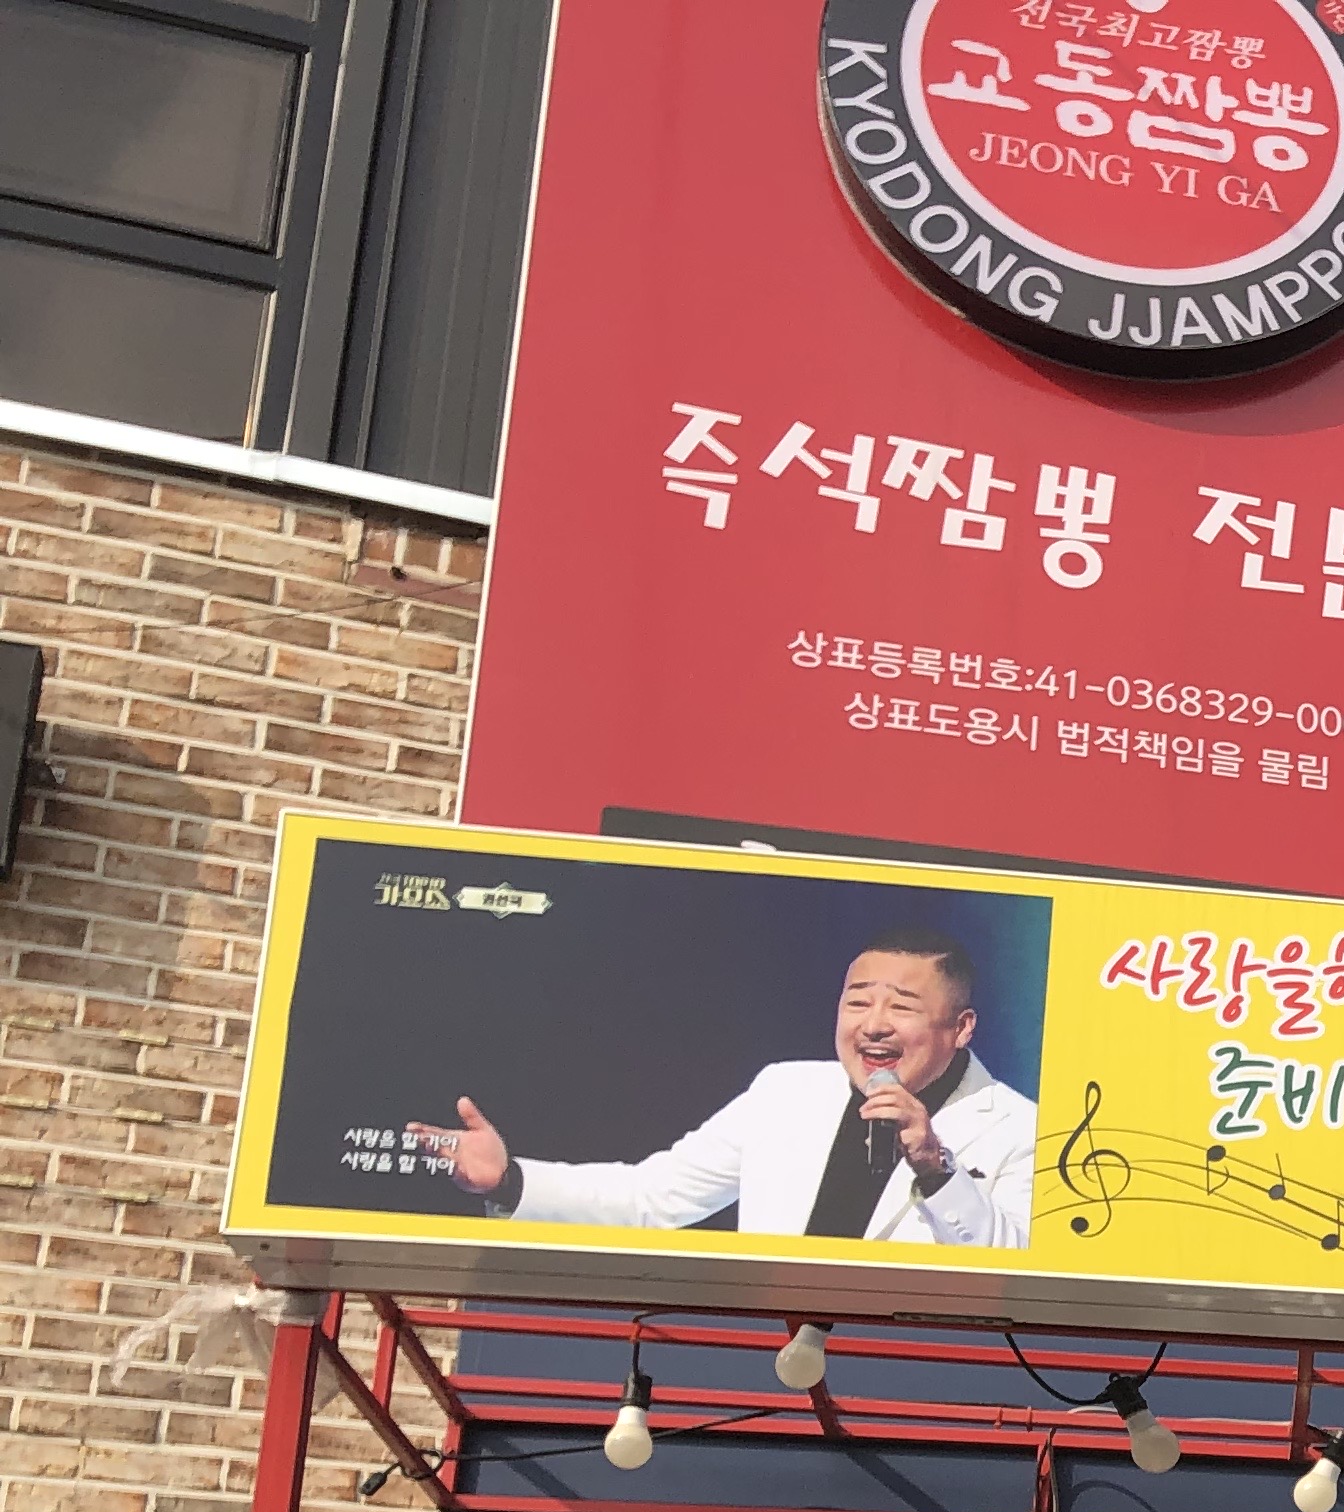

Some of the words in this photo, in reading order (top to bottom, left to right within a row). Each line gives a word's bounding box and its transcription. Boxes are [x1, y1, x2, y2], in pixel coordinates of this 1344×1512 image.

[928, 38, 1329, 173] 교동짬뽕
[969, 132, 1131, 187] JEONG
[1148, 163, 1200, 199] YI
[1216, 176, 1283, 213] GA
[826, 37, 1066, 323] KYODONG
[661, 401, 1117, 590] 즉석짬뽕
[844, 692, 1041, 753] 상표도용시
[1056, 718, 1245, 780] 법적책임을
[1257, 746, 1331, 792] 물림
